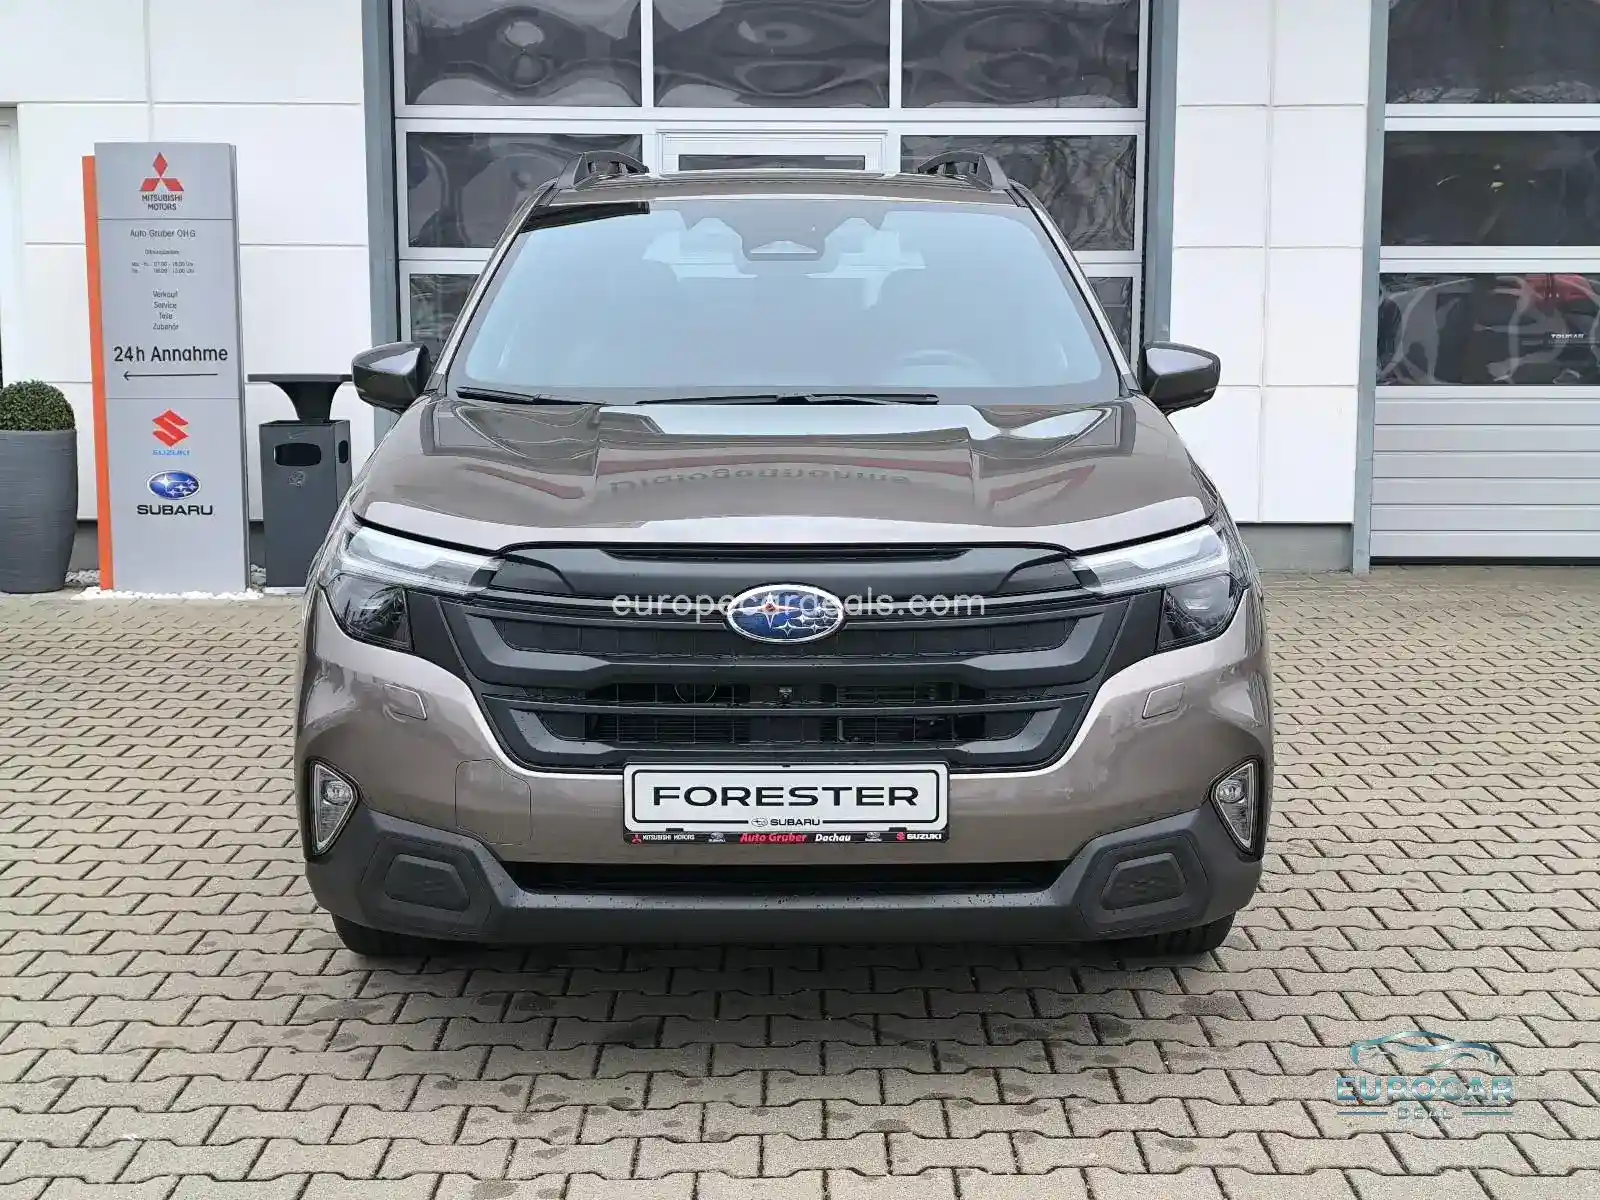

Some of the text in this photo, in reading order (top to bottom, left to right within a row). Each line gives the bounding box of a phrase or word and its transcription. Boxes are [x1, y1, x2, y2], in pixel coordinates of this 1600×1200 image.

[142, 194, 183, 202] MITSUBISHI
[147, 203, 177, 211] MOTORS
[130, 229, 147, 238] Auto
[149, 229, 175, 238] Gruber
[152, 290, 178, 298] Verkauf
[153, 301, 177, 309] Service
[150, 346, 228, 362] Annahme
[136, 504, 213, 515] SUBARU
[652, 786, 919, 806] FORESTER
[769, 818, 821, 827] SUBARU
[740, 833, 851, 843] Auto Gruber Dachau
